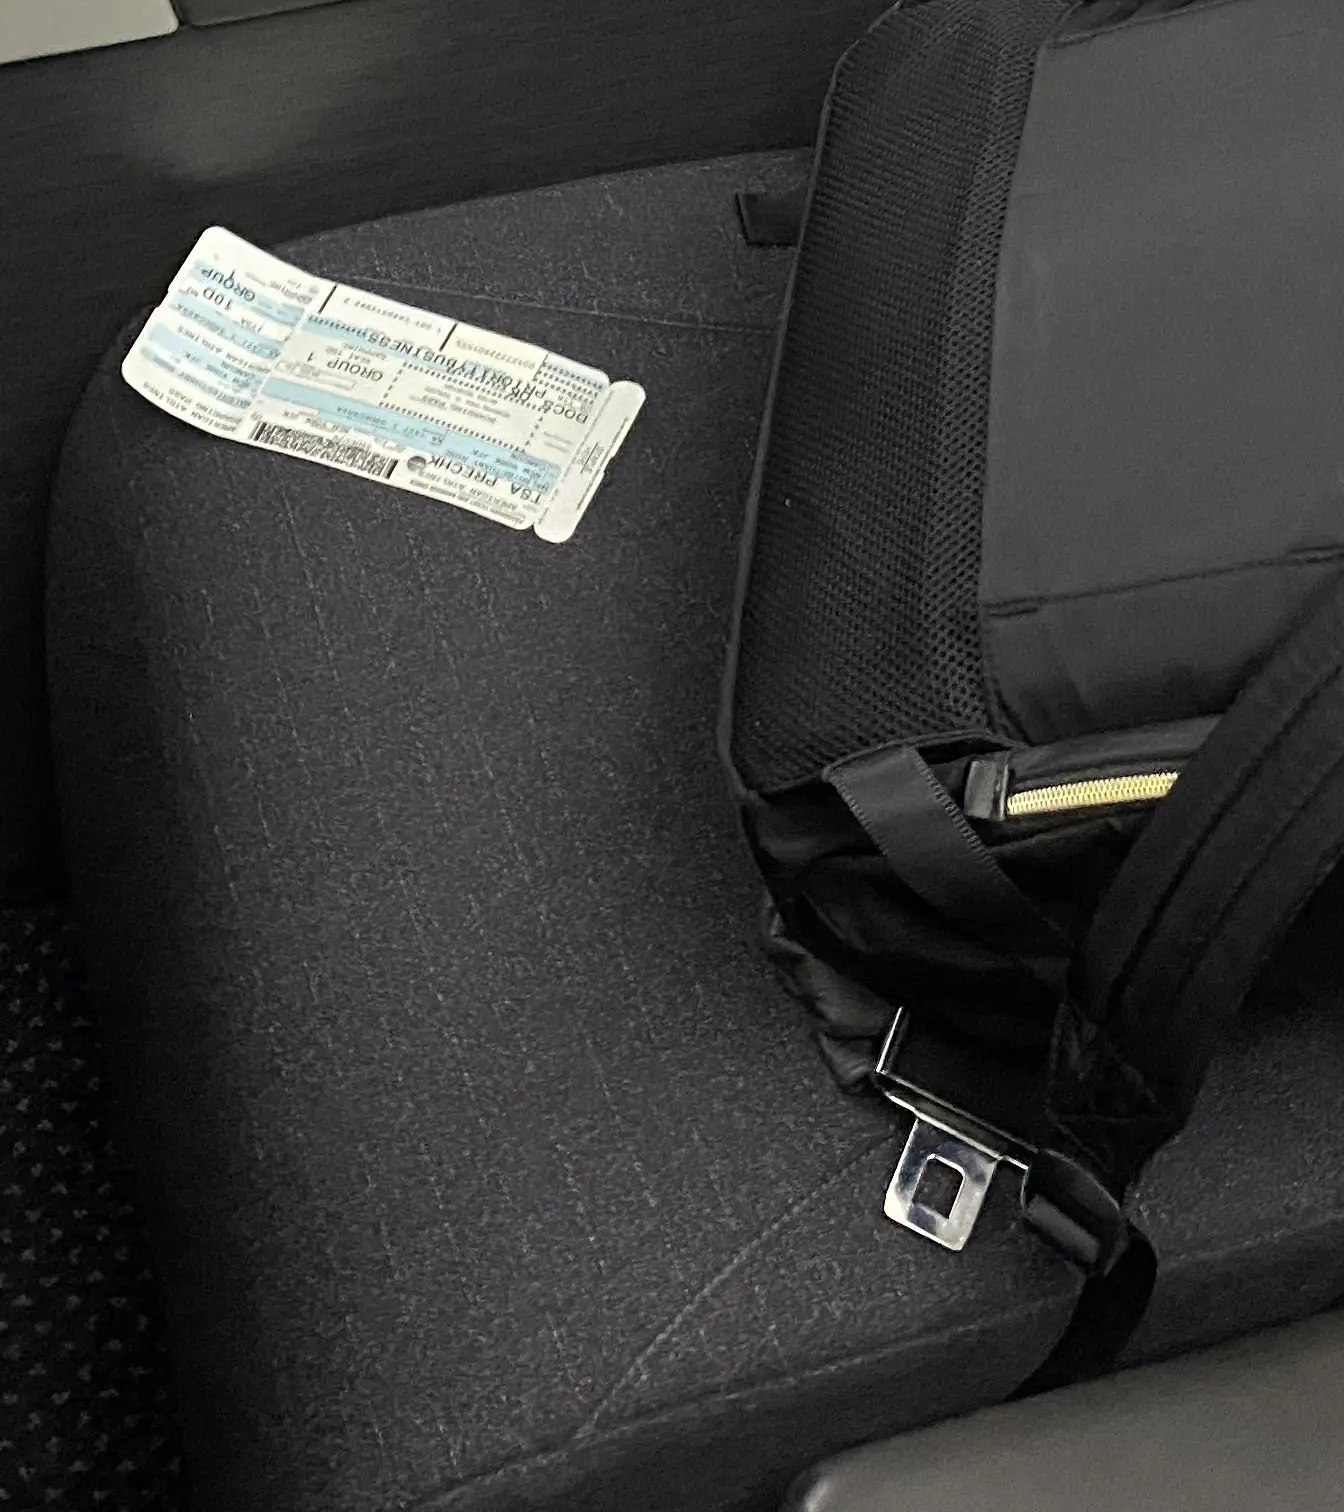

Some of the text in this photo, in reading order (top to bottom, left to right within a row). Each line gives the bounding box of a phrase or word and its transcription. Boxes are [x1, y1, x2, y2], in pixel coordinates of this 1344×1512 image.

[199, 265, 257, 303] GROUP
[306, 351, 383, 384] GROUP 1
[426, 453, 498, 488] PRECHK
[508, 482, 542, 504] TSA
